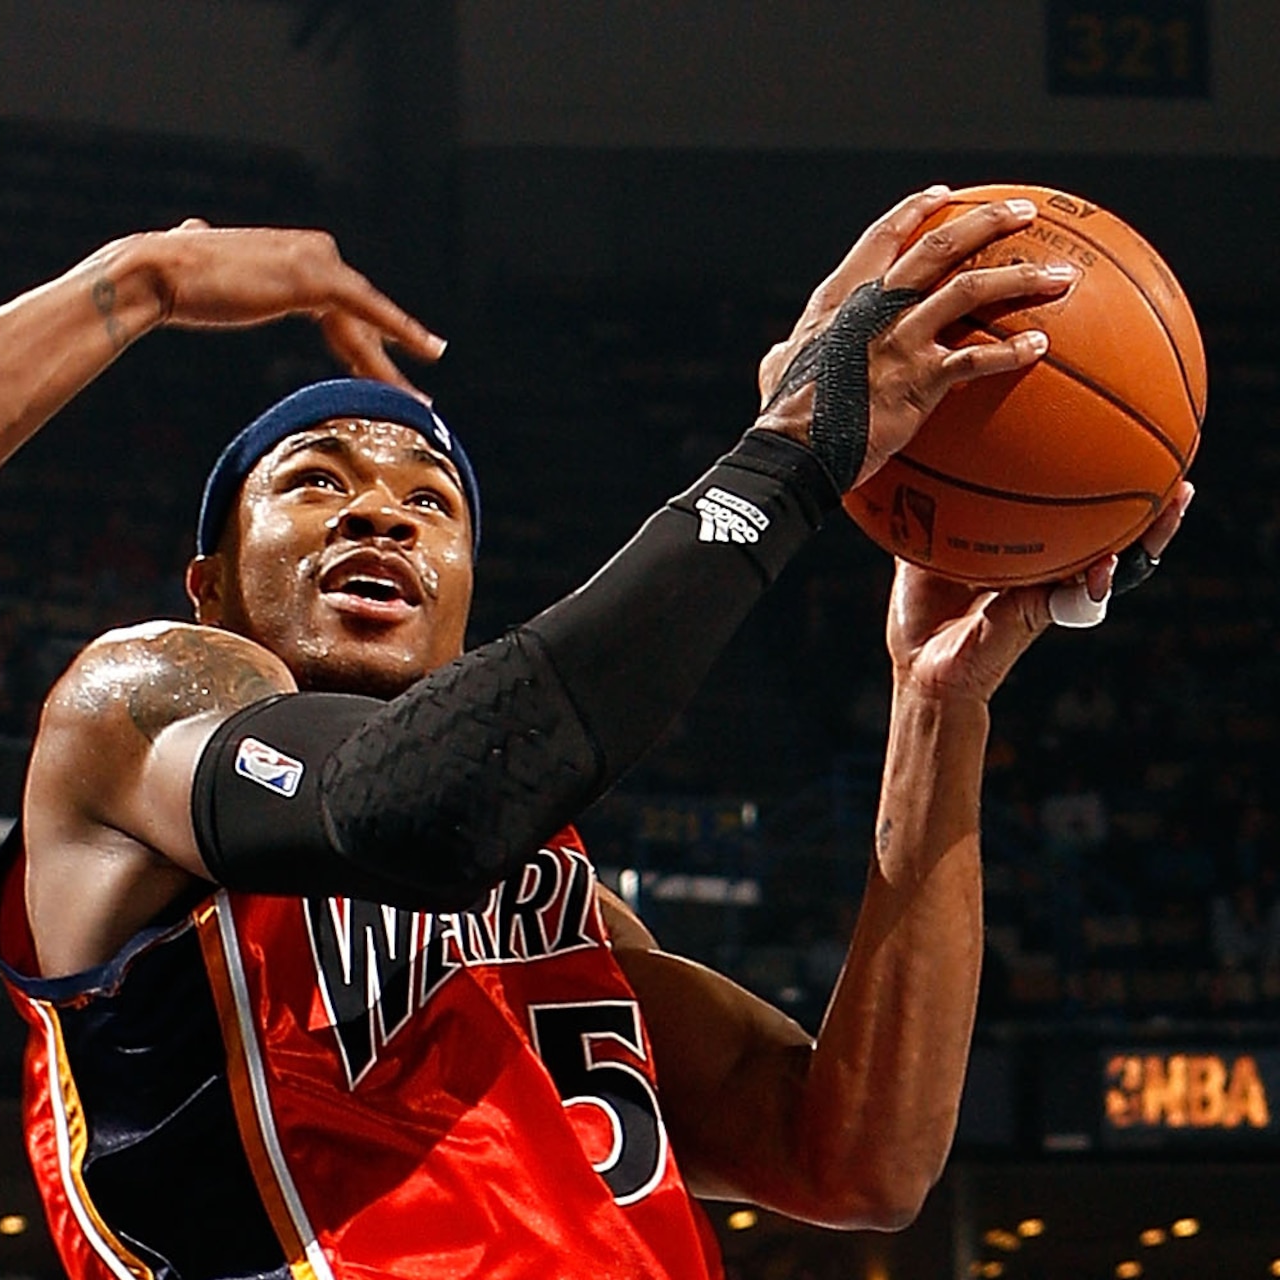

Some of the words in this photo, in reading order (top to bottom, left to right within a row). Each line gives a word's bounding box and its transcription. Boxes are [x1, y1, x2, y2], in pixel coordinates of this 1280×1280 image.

[1064, 14, 1193, 79] 321
[1023, 226, 1098, 268] NETS
[303, 848, 600, 1092] WRRI
[528, 1000, 665, 1207] 5
